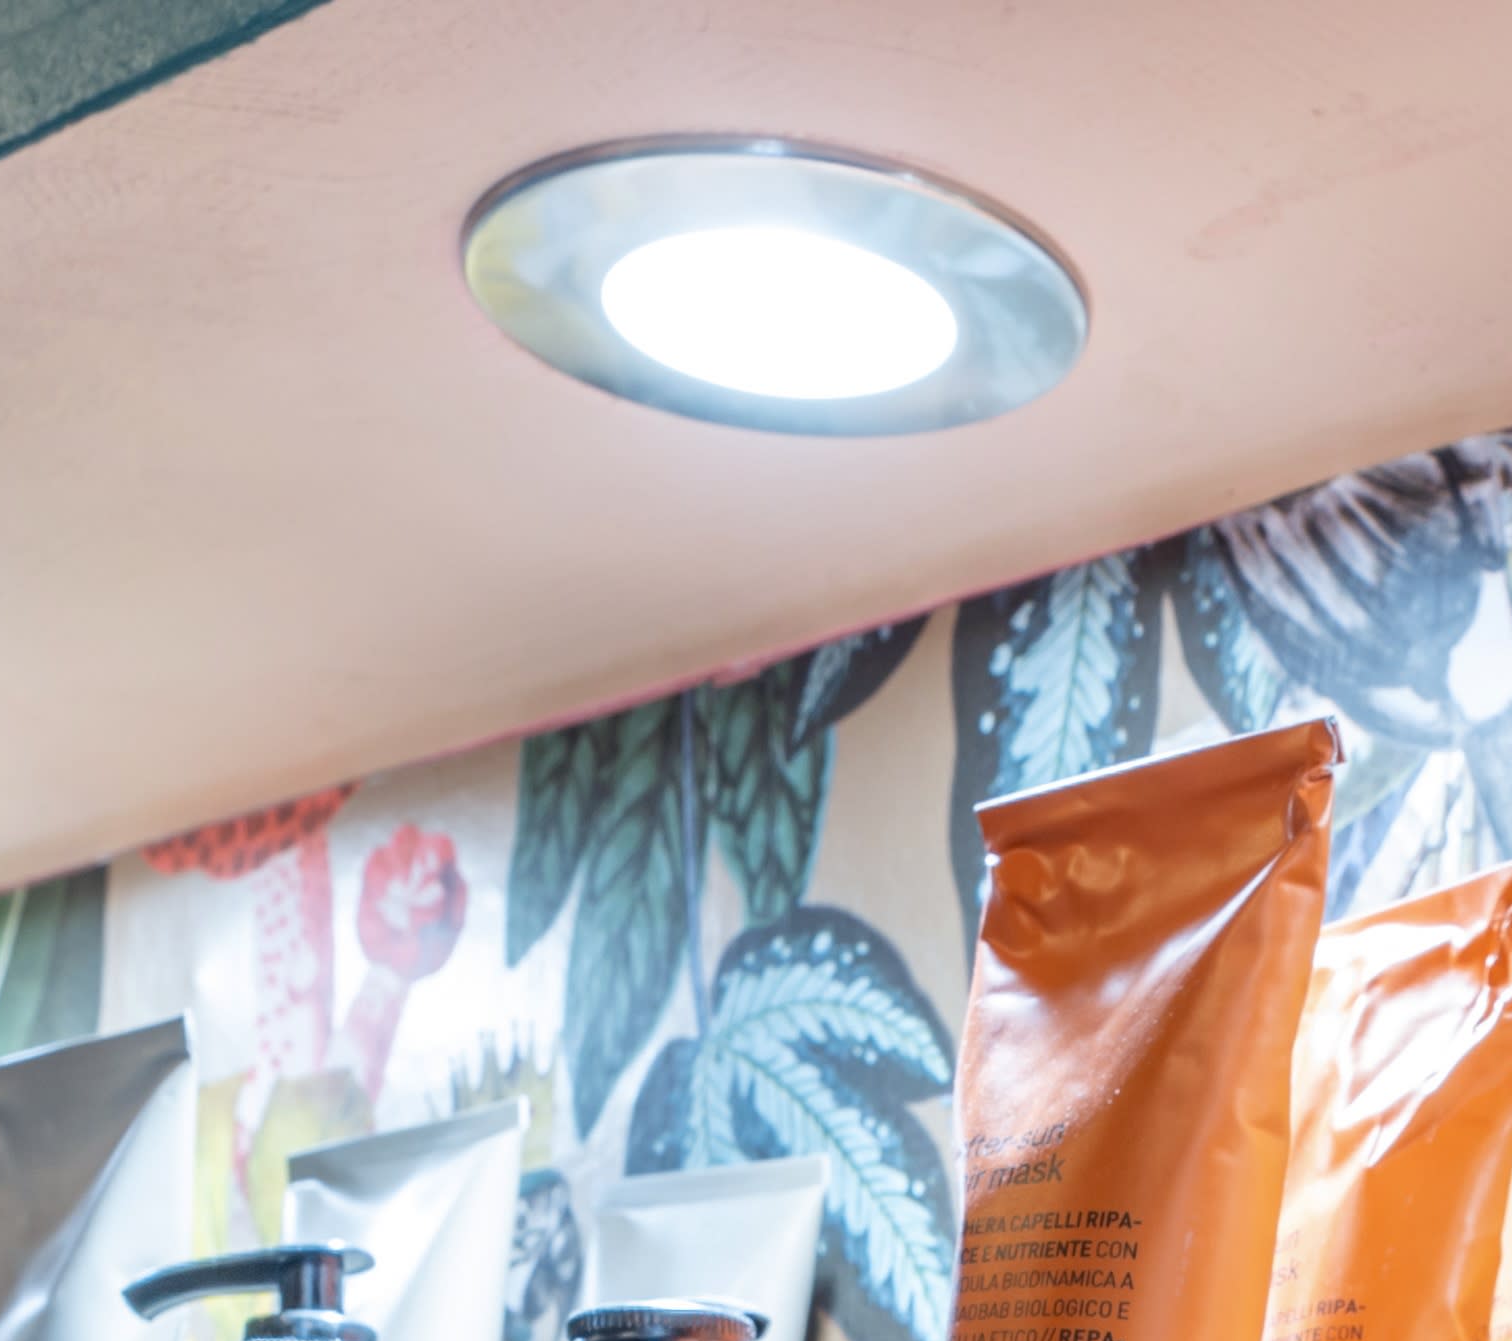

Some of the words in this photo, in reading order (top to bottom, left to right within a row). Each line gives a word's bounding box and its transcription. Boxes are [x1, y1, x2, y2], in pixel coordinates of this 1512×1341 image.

[989, 1155, 1064, 1189] mask
[1087, 1211, 1142, 1229] RIPA-
[996, 1241, 1092, 1261] NUTRIENTE
[1096, 1241, 1137, 1259] CON
[1015, 1300, 1112, 1319] BIOLOGICO
